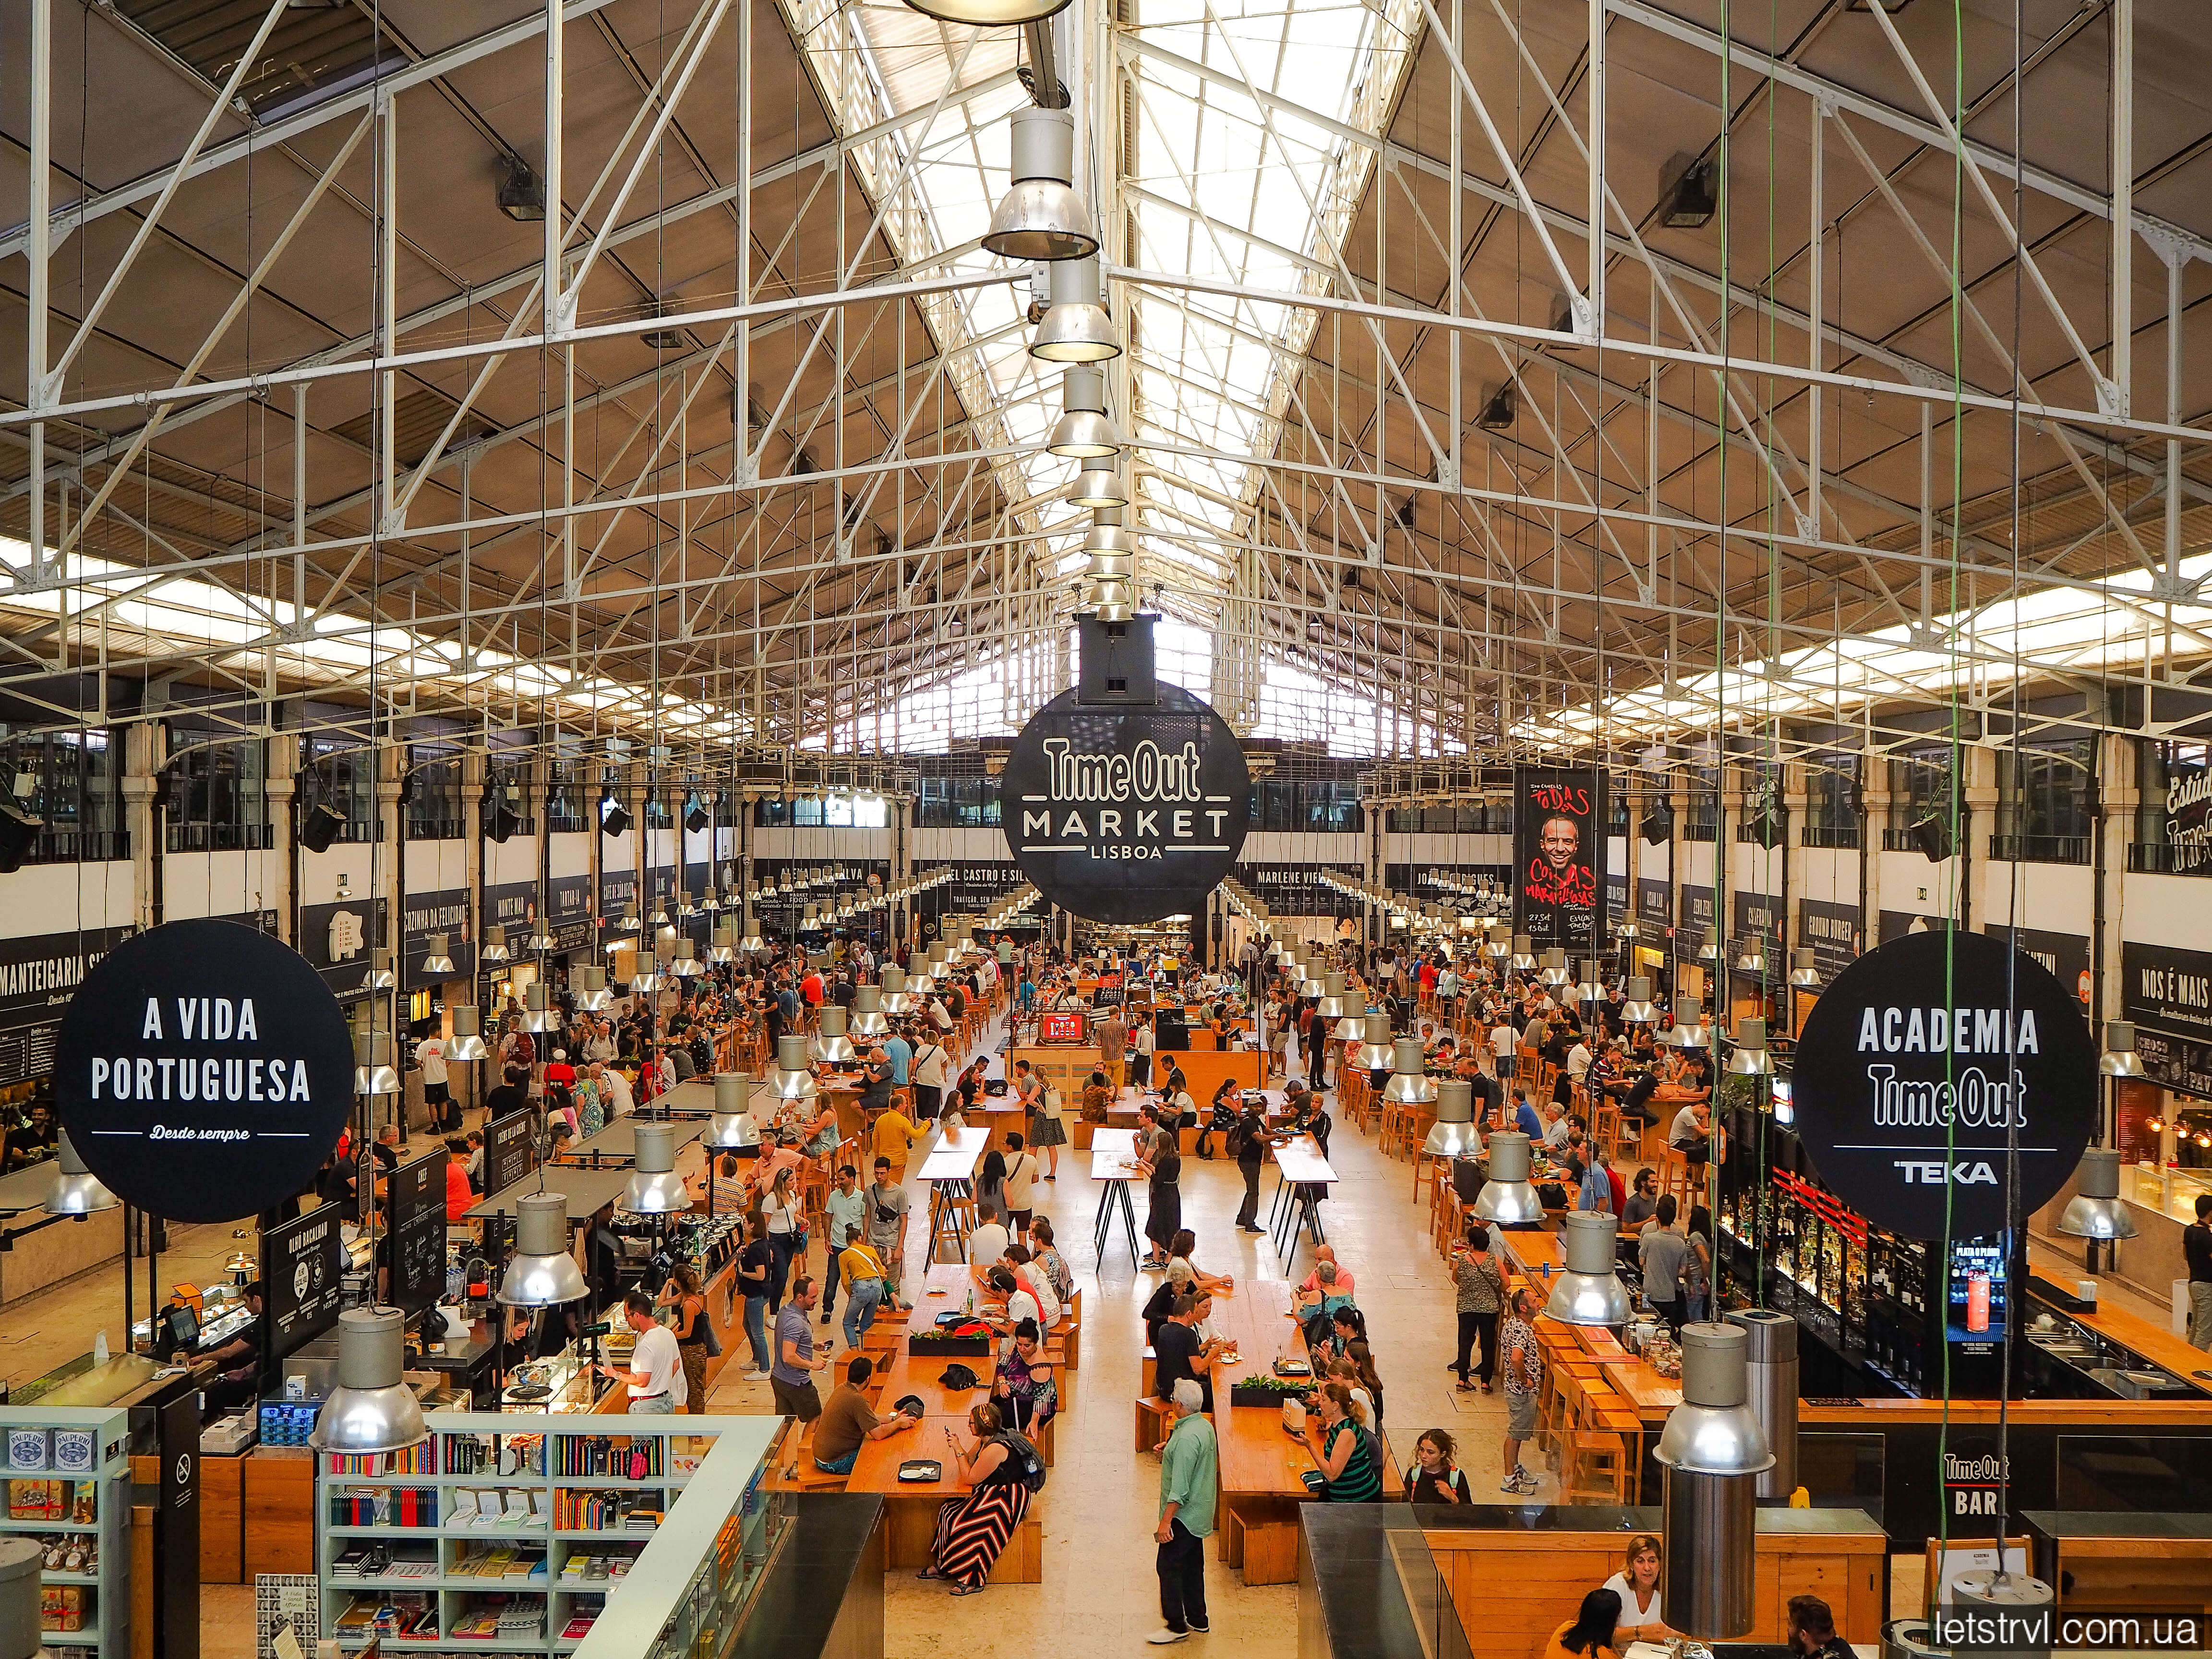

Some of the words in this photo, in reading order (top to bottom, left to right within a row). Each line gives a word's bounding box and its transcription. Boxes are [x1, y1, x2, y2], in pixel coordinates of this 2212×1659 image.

[2166, 767, 2212, 814] Estúd
[1023, 810, 1228, 838] MARKET
[1091, 845, 1162, 860] LISBOA
[963, 869, 998, 881] CASTRO
[1002, 869, 1007, 881] E
[1010, 869, 1024, 881] SIL
[1258, 872, 1300, 883] MARLENE
[404, 909, 429, 933] COZINHA
[430, 908, 438, 928] DA
[1809, 915, 1829, 938] GROUND
[1830, 919, 1852, 942] BURGER
[0, 955, 84, 997] MANTEIGARIA
[2168, 967, 2174, 1002] É
[2178, 974, 2208, 1008] MAIS
[143, 998, 163, 1039] A
[179, 998, 258, 1040] VIDA
[1857, 1008, 2039, 1054] ACADEMIA
[92, 1058, 310, 1102] PORTUGUESA
[149, 1124, 196, 1140] Desde
[197, 1128, 250, 1142] sempre
[1894, 1161, 1998, 1184] TEKA
[289, 1231, 302, 1254] OLHÓ
[303, 1221, 328, 1247] BACALHAU
[1956, 1247, 1974, 1257] PLATA
[1955, 1491, 1997, 1515] BAR
